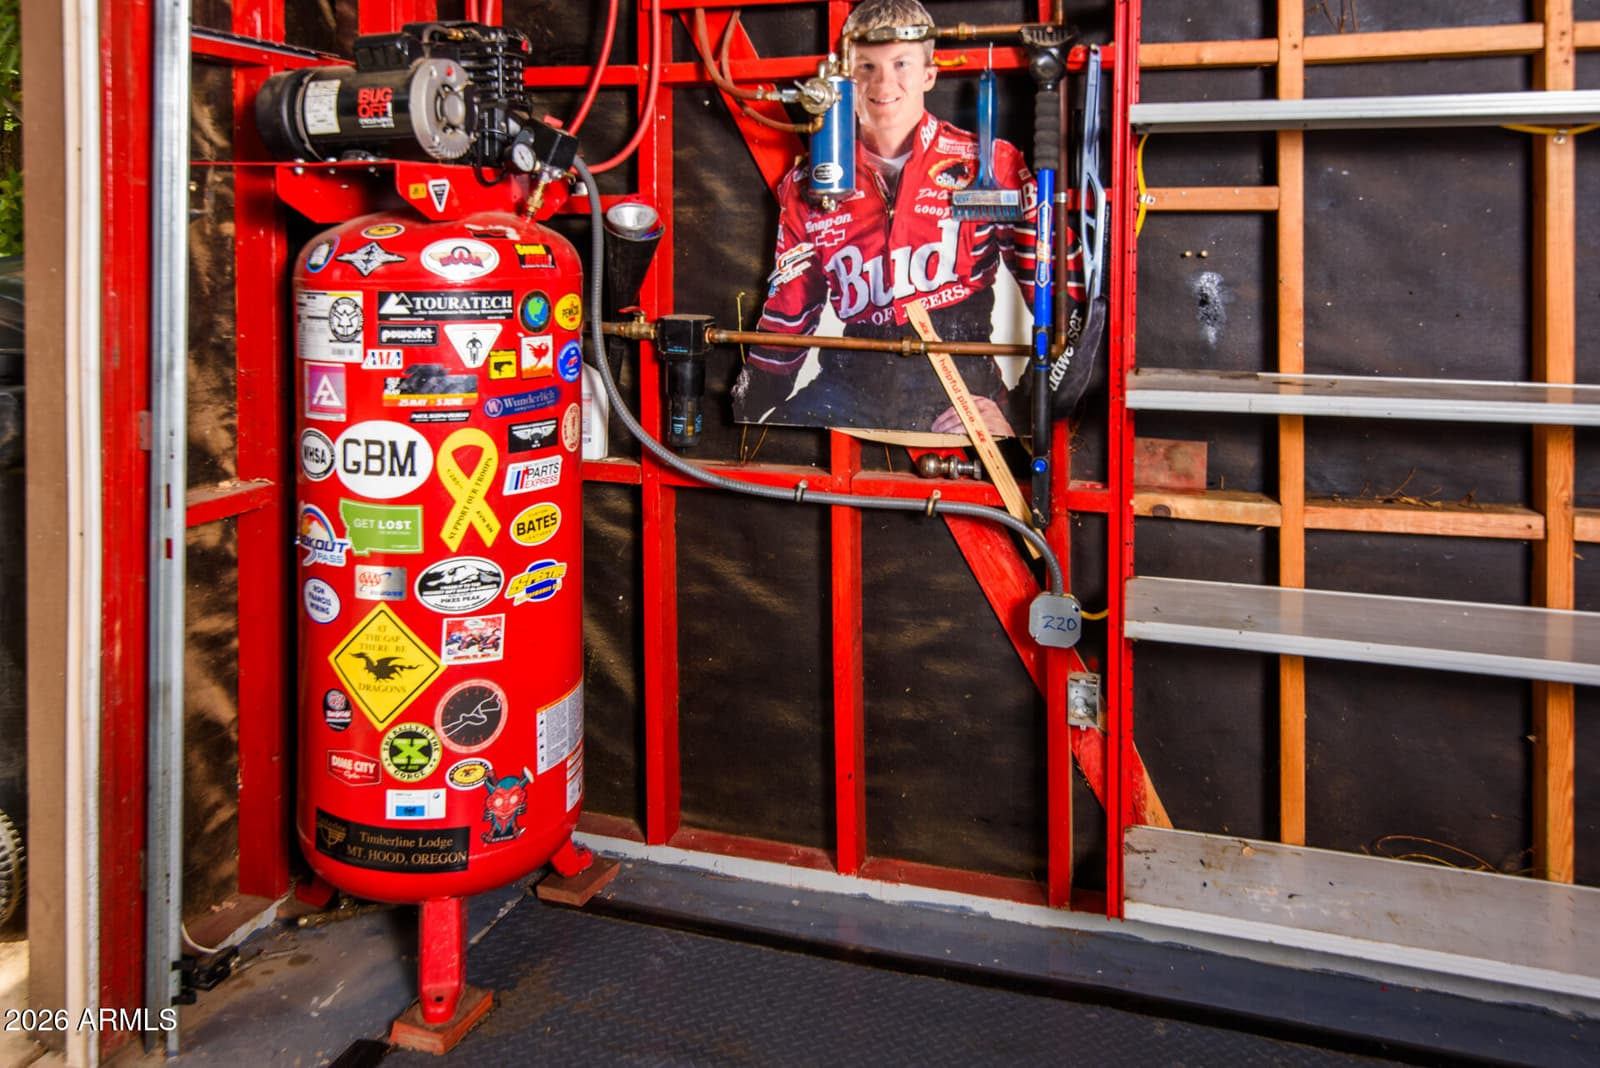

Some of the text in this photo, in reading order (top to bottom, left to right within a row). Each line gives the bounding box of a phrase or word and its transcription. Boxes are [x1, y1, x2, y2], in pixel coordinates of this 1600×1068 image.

[358, 87, 393, 103] BUG
[824, 218, 960, 319] Bud
[412, 296, 513, 311] TOURATECH
[939, 358, 961, 394] helpful
[343, 438, 418, 477] GBM
[523, 463, 560, 480] PARTS
[525, 474, 558, 489] EXPRESS
[353, 518, 413, 530] GET LOST
[516, 512, 557, 536] BATES
[317, 553, 344, 565] PASS
[1041, 615, 1078, 632] 220
[383, 635, 401, 643] GAP
[360, 643, 388, 652] THERE
[358, 682, 407, 693] DRAGONS
[353, 761, 376, 774] CITY
[359, 830, 454, 849] Timberline Lodge
[411, 851, 468, 865] OREGON
